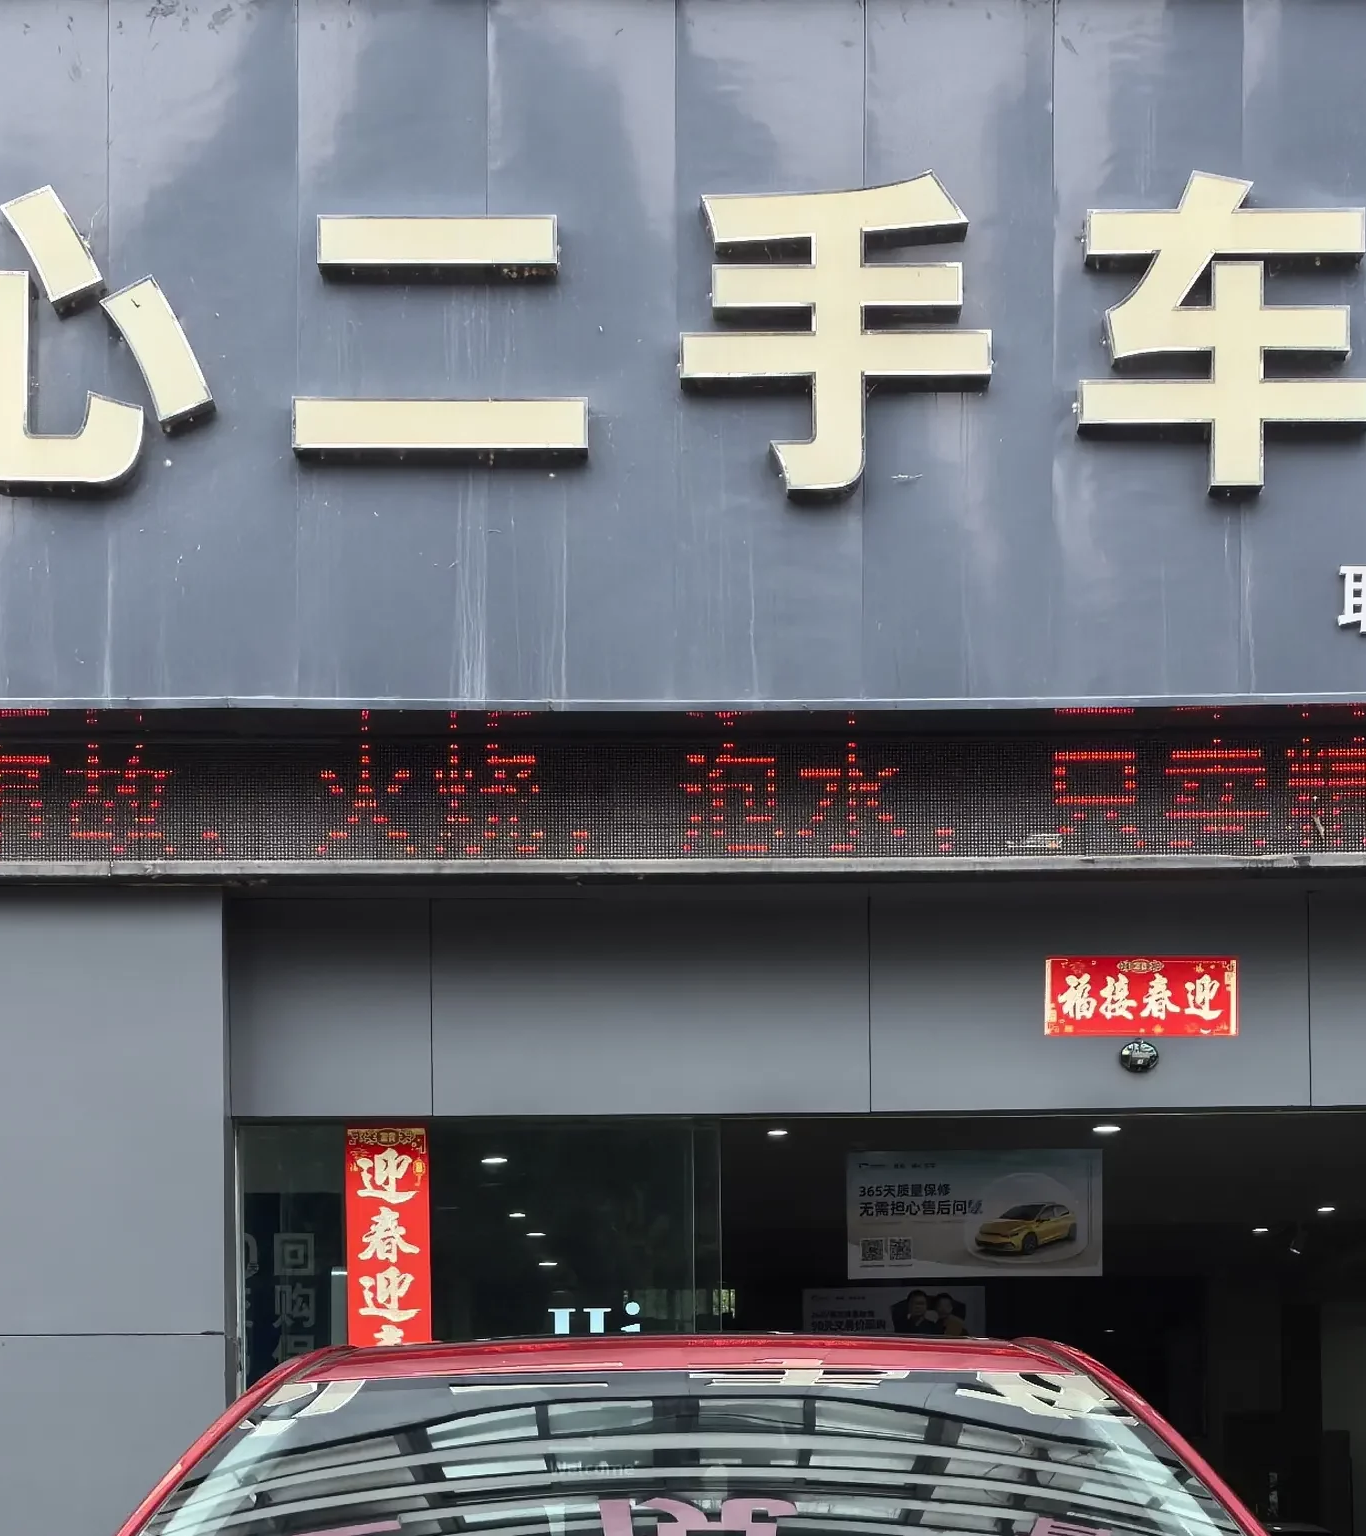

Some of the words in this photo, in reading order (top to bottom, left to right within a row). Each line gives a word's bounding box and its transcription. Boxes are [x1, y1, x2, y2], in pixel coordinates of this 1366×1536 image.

[858, 1182, 952, 1198] 365天质量保修
